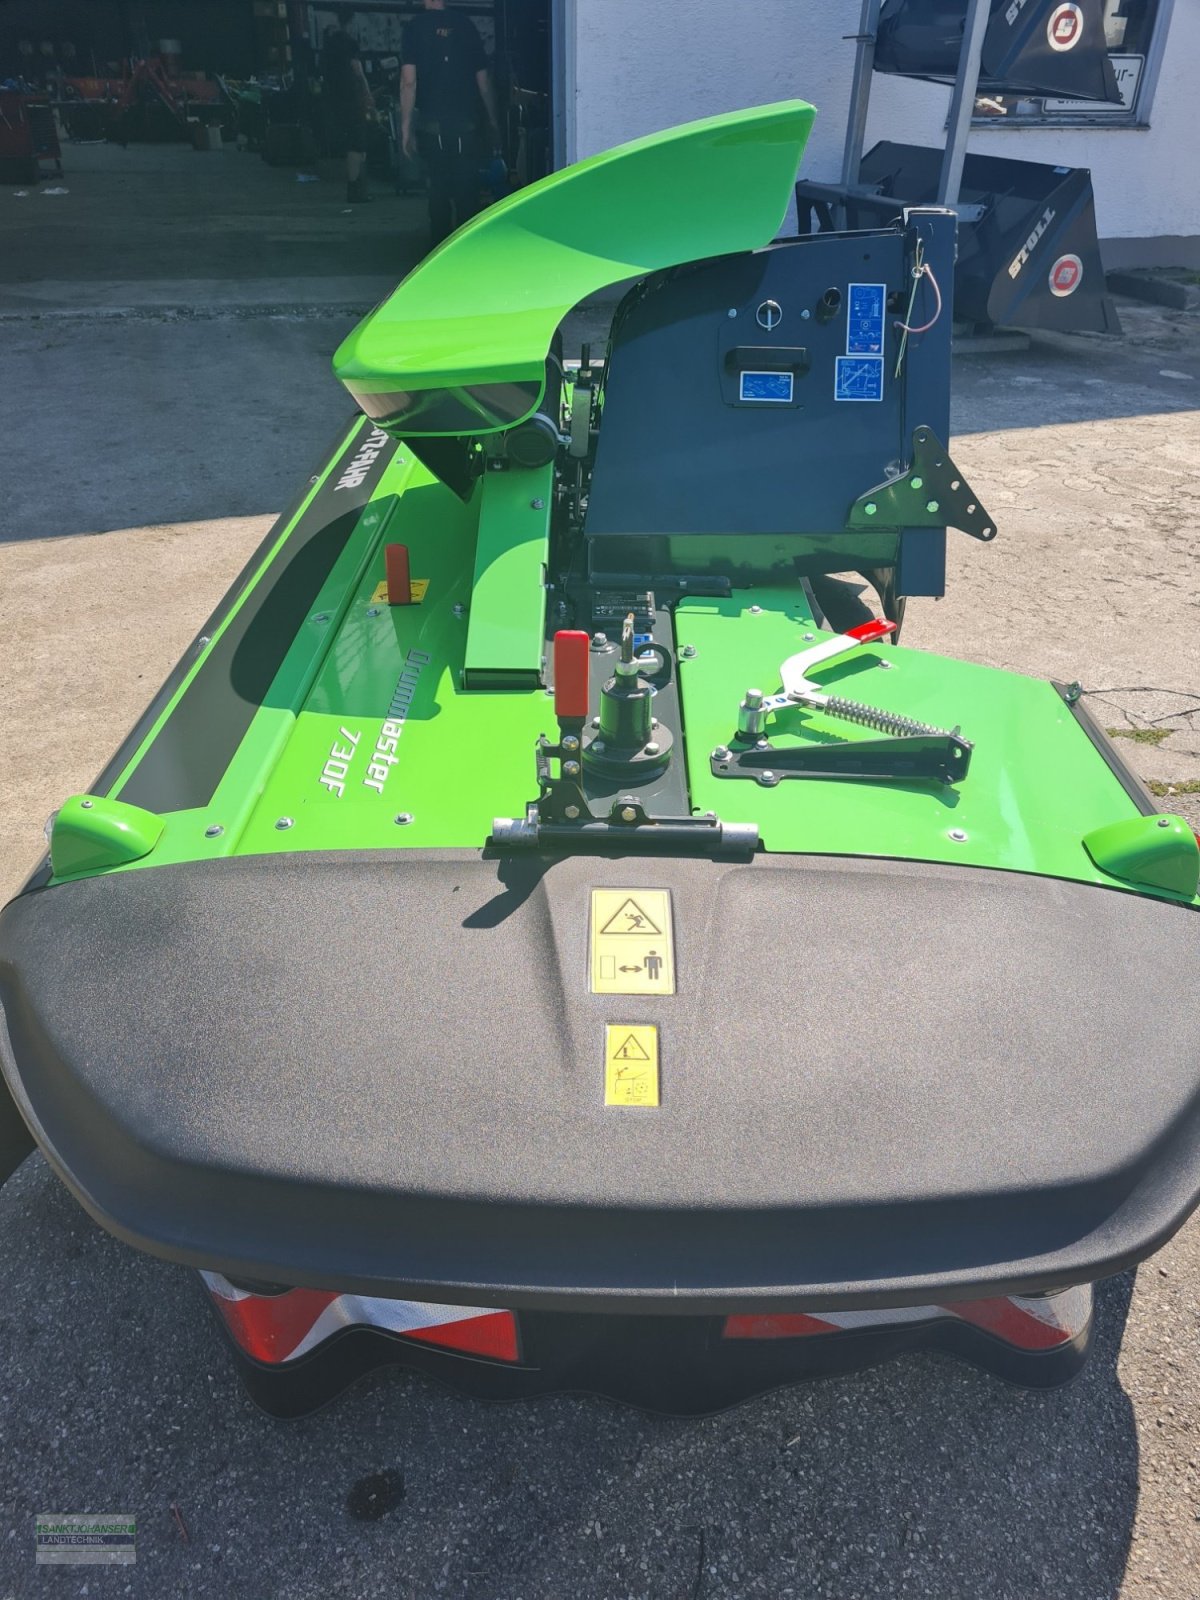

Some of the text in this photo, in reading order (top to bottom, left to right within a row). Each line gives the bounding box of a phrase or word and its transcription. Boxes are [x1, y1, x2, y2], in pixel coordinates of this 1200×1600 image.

[1114, 69, 1134, 82] ur-
[1008, 207, 1056, 280] STOLL
[333, 426, 389, 492] UTZ-FAHR
[363, 648, 431, 795] Drummaster
[319, 725, 362, 799] 730F
